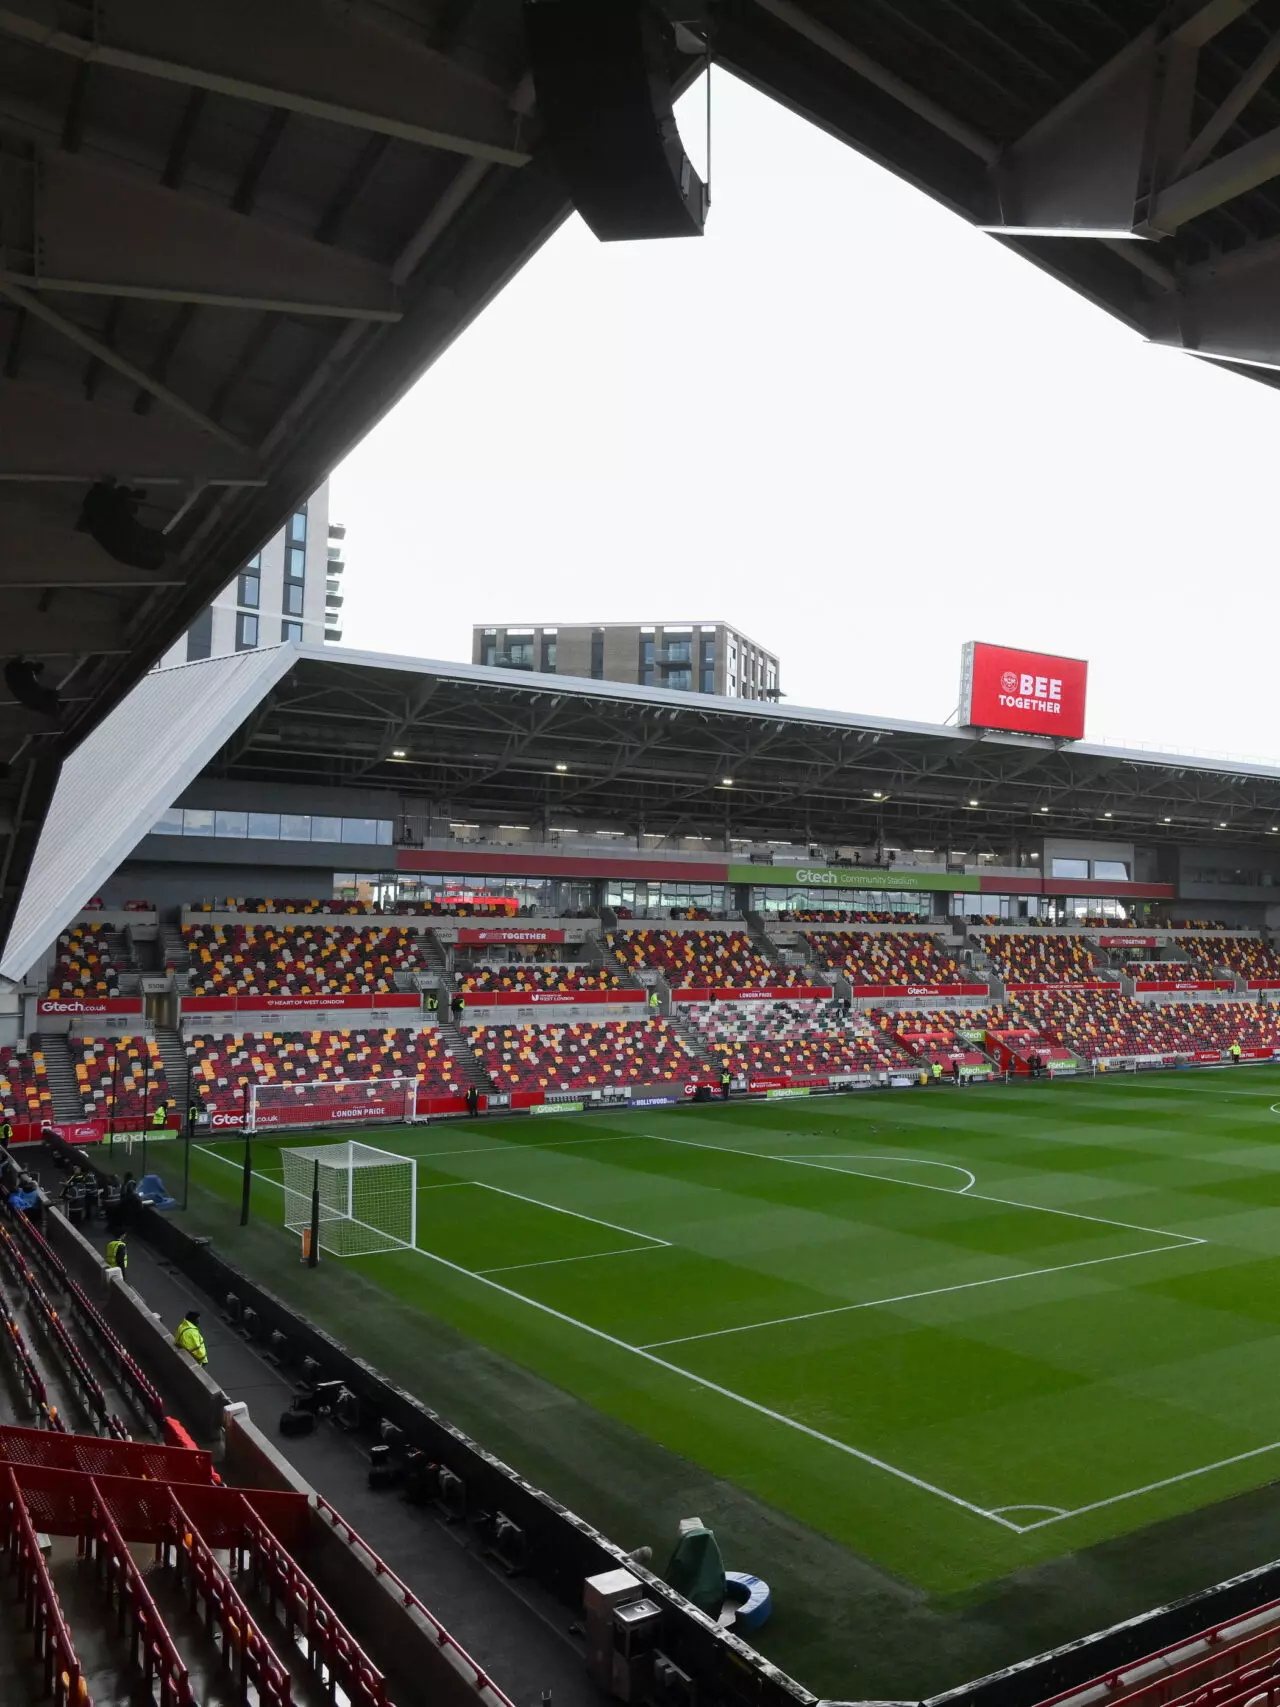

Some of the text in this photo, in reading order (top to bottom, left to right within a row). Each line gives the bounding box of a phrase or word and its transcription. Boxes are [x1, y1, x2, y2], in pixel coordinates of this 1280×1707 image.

[1019, 674, 1062, 700] BEE
[998, 694, 1061, 714] TOGETHER
[795, 869, 918, 885] Gtech Community Stadium
[41, 1001, 107, 1012] Gtech.co.uk
[331, 1109, 363, 1118] LONDON
[363, 1107, 385, 1116] PRIDE
